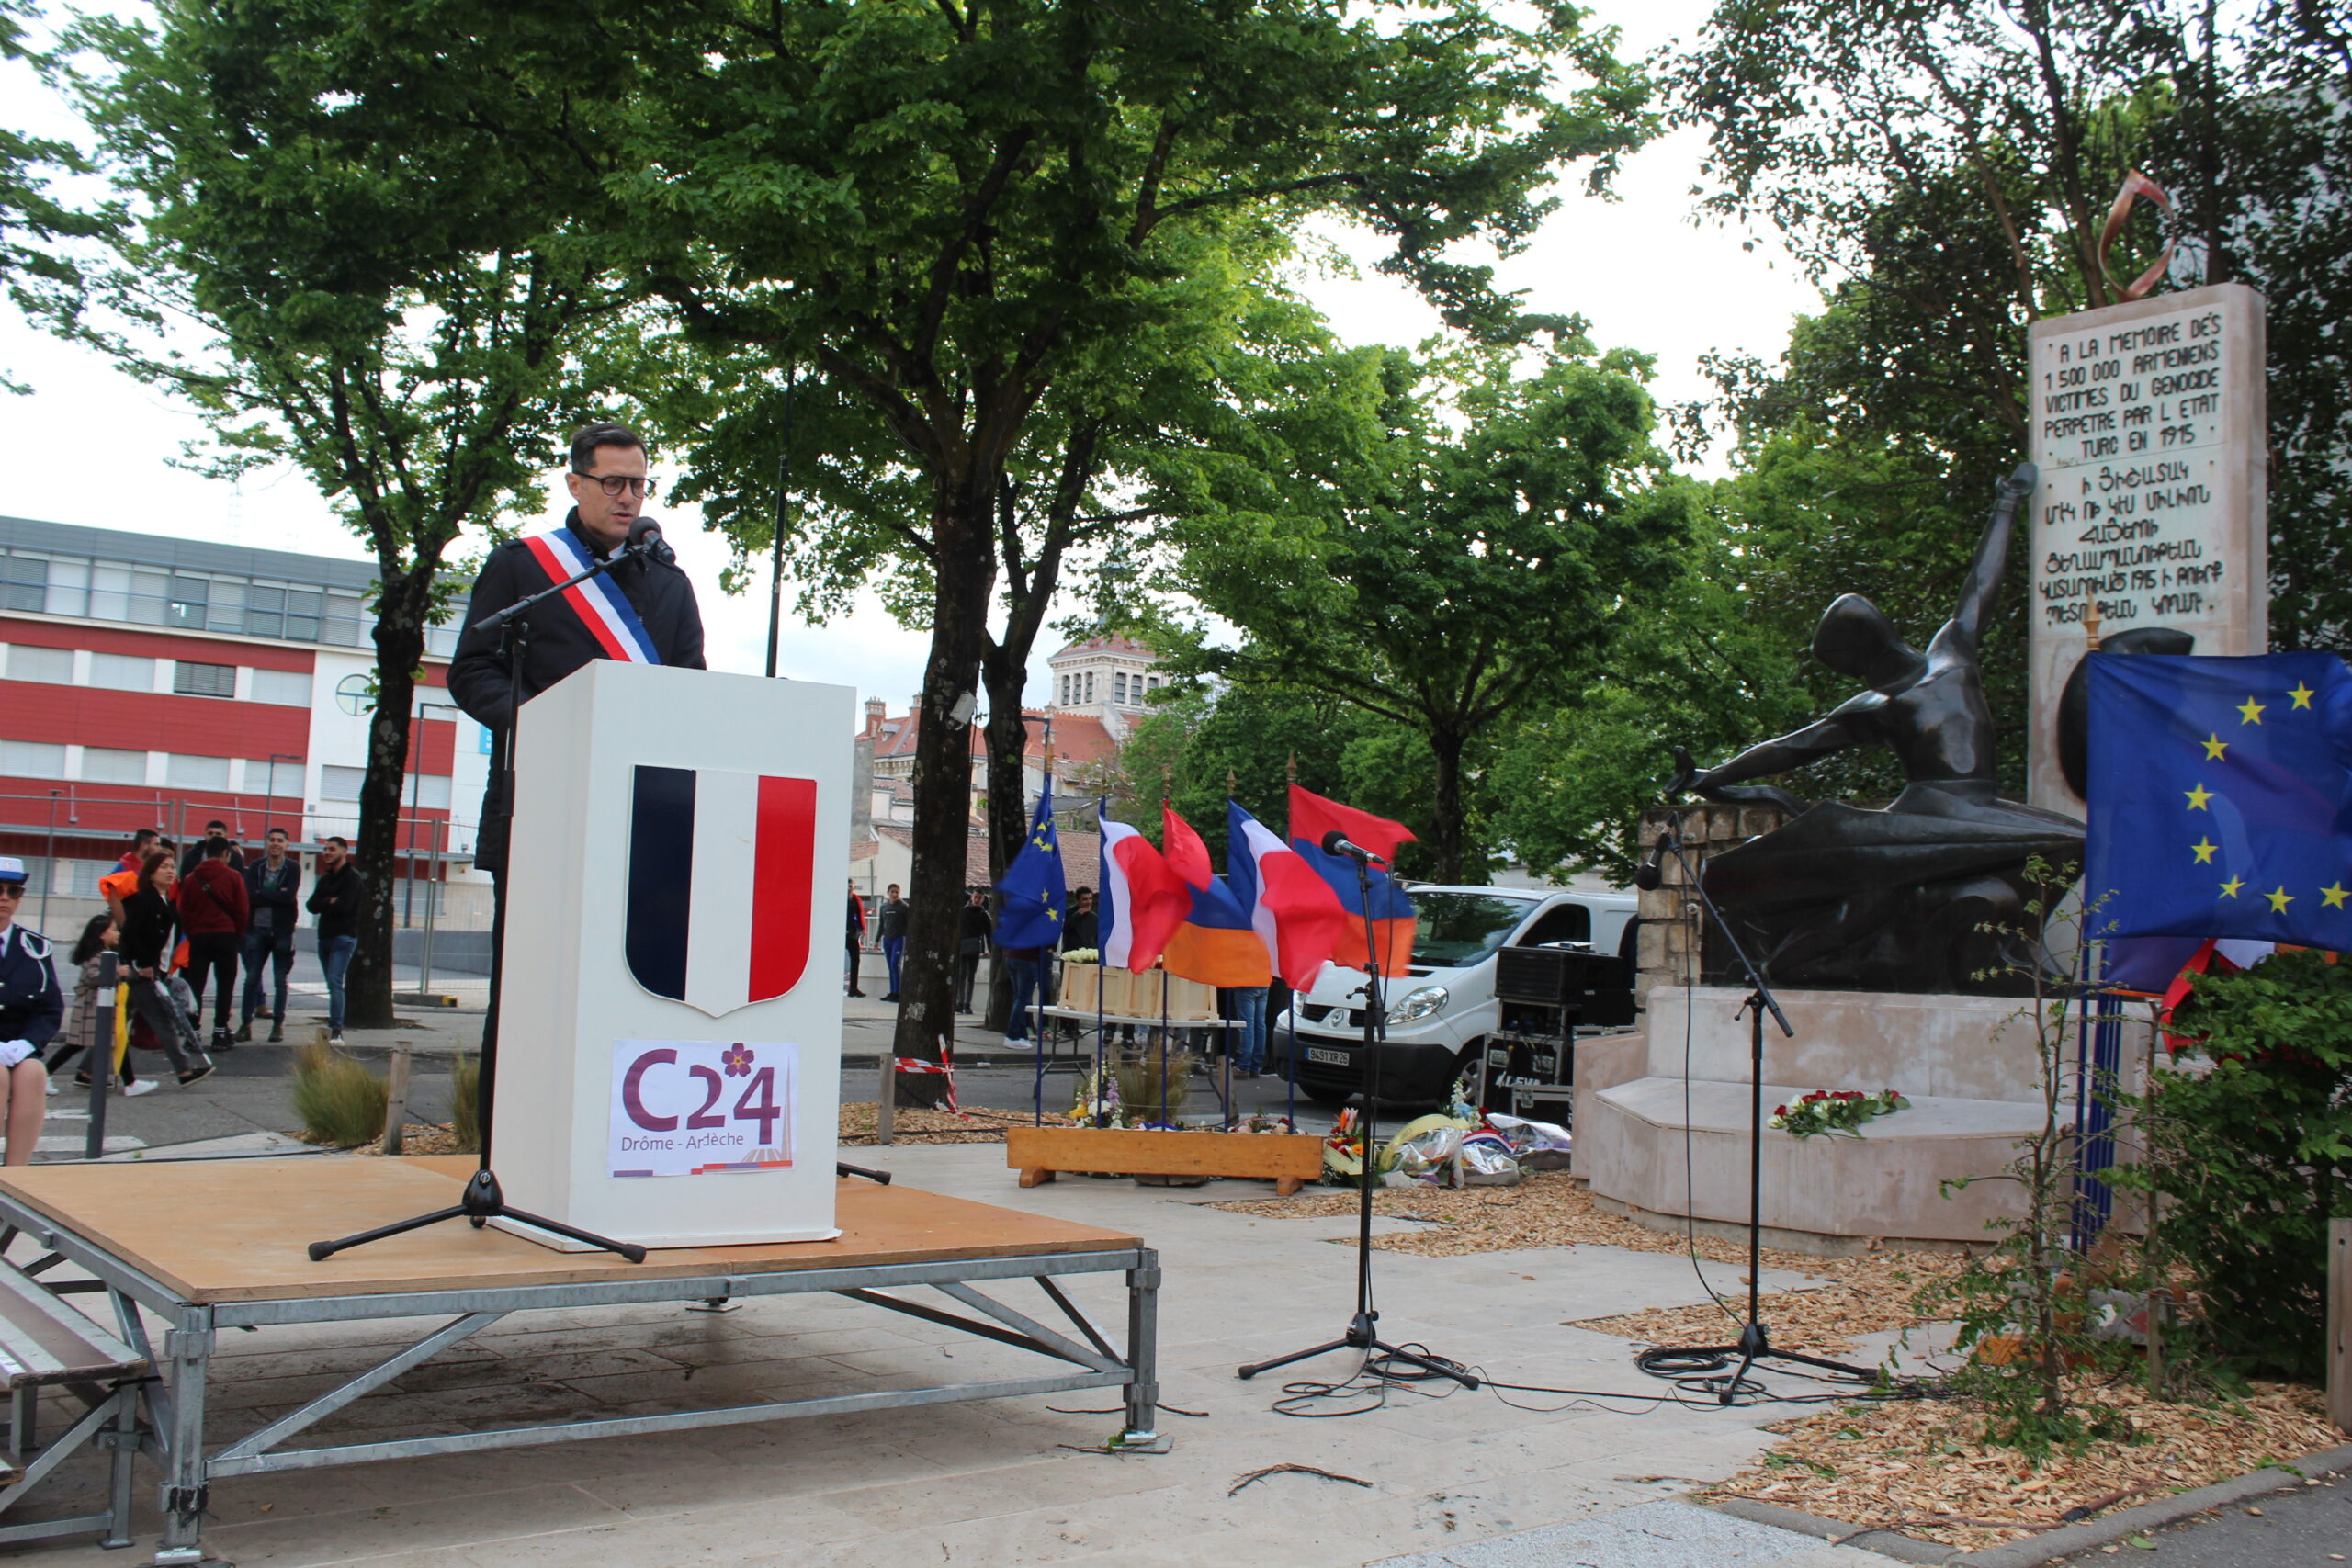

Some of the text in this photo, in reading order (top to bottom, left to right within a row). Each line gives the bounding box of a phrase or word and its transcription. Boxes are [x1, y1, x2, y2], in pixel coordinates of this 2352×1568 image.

[2060, 314, 2221, 364] A LA MEMOIRE DES
[2044, 339, 2220, 391] 1 500 000 ARMENIENS
[2045, 367, 2220, 413] VICTIMES DU GENOCIDE
[2044, 411, 2117, 439] PERPETRE
[2123, 405, 2153, 428] PAR
[2179, 393, 2220, 419] ETAT
[2081, 423, 2196, 458] TURC EN 1915
[2132, 570, 2157, 591] 1915
[622, 1048, 781, 1145] C24
[621, 1136, 673, 1152] Drôme
[686, 1132, 744, 1150] Ardèche
